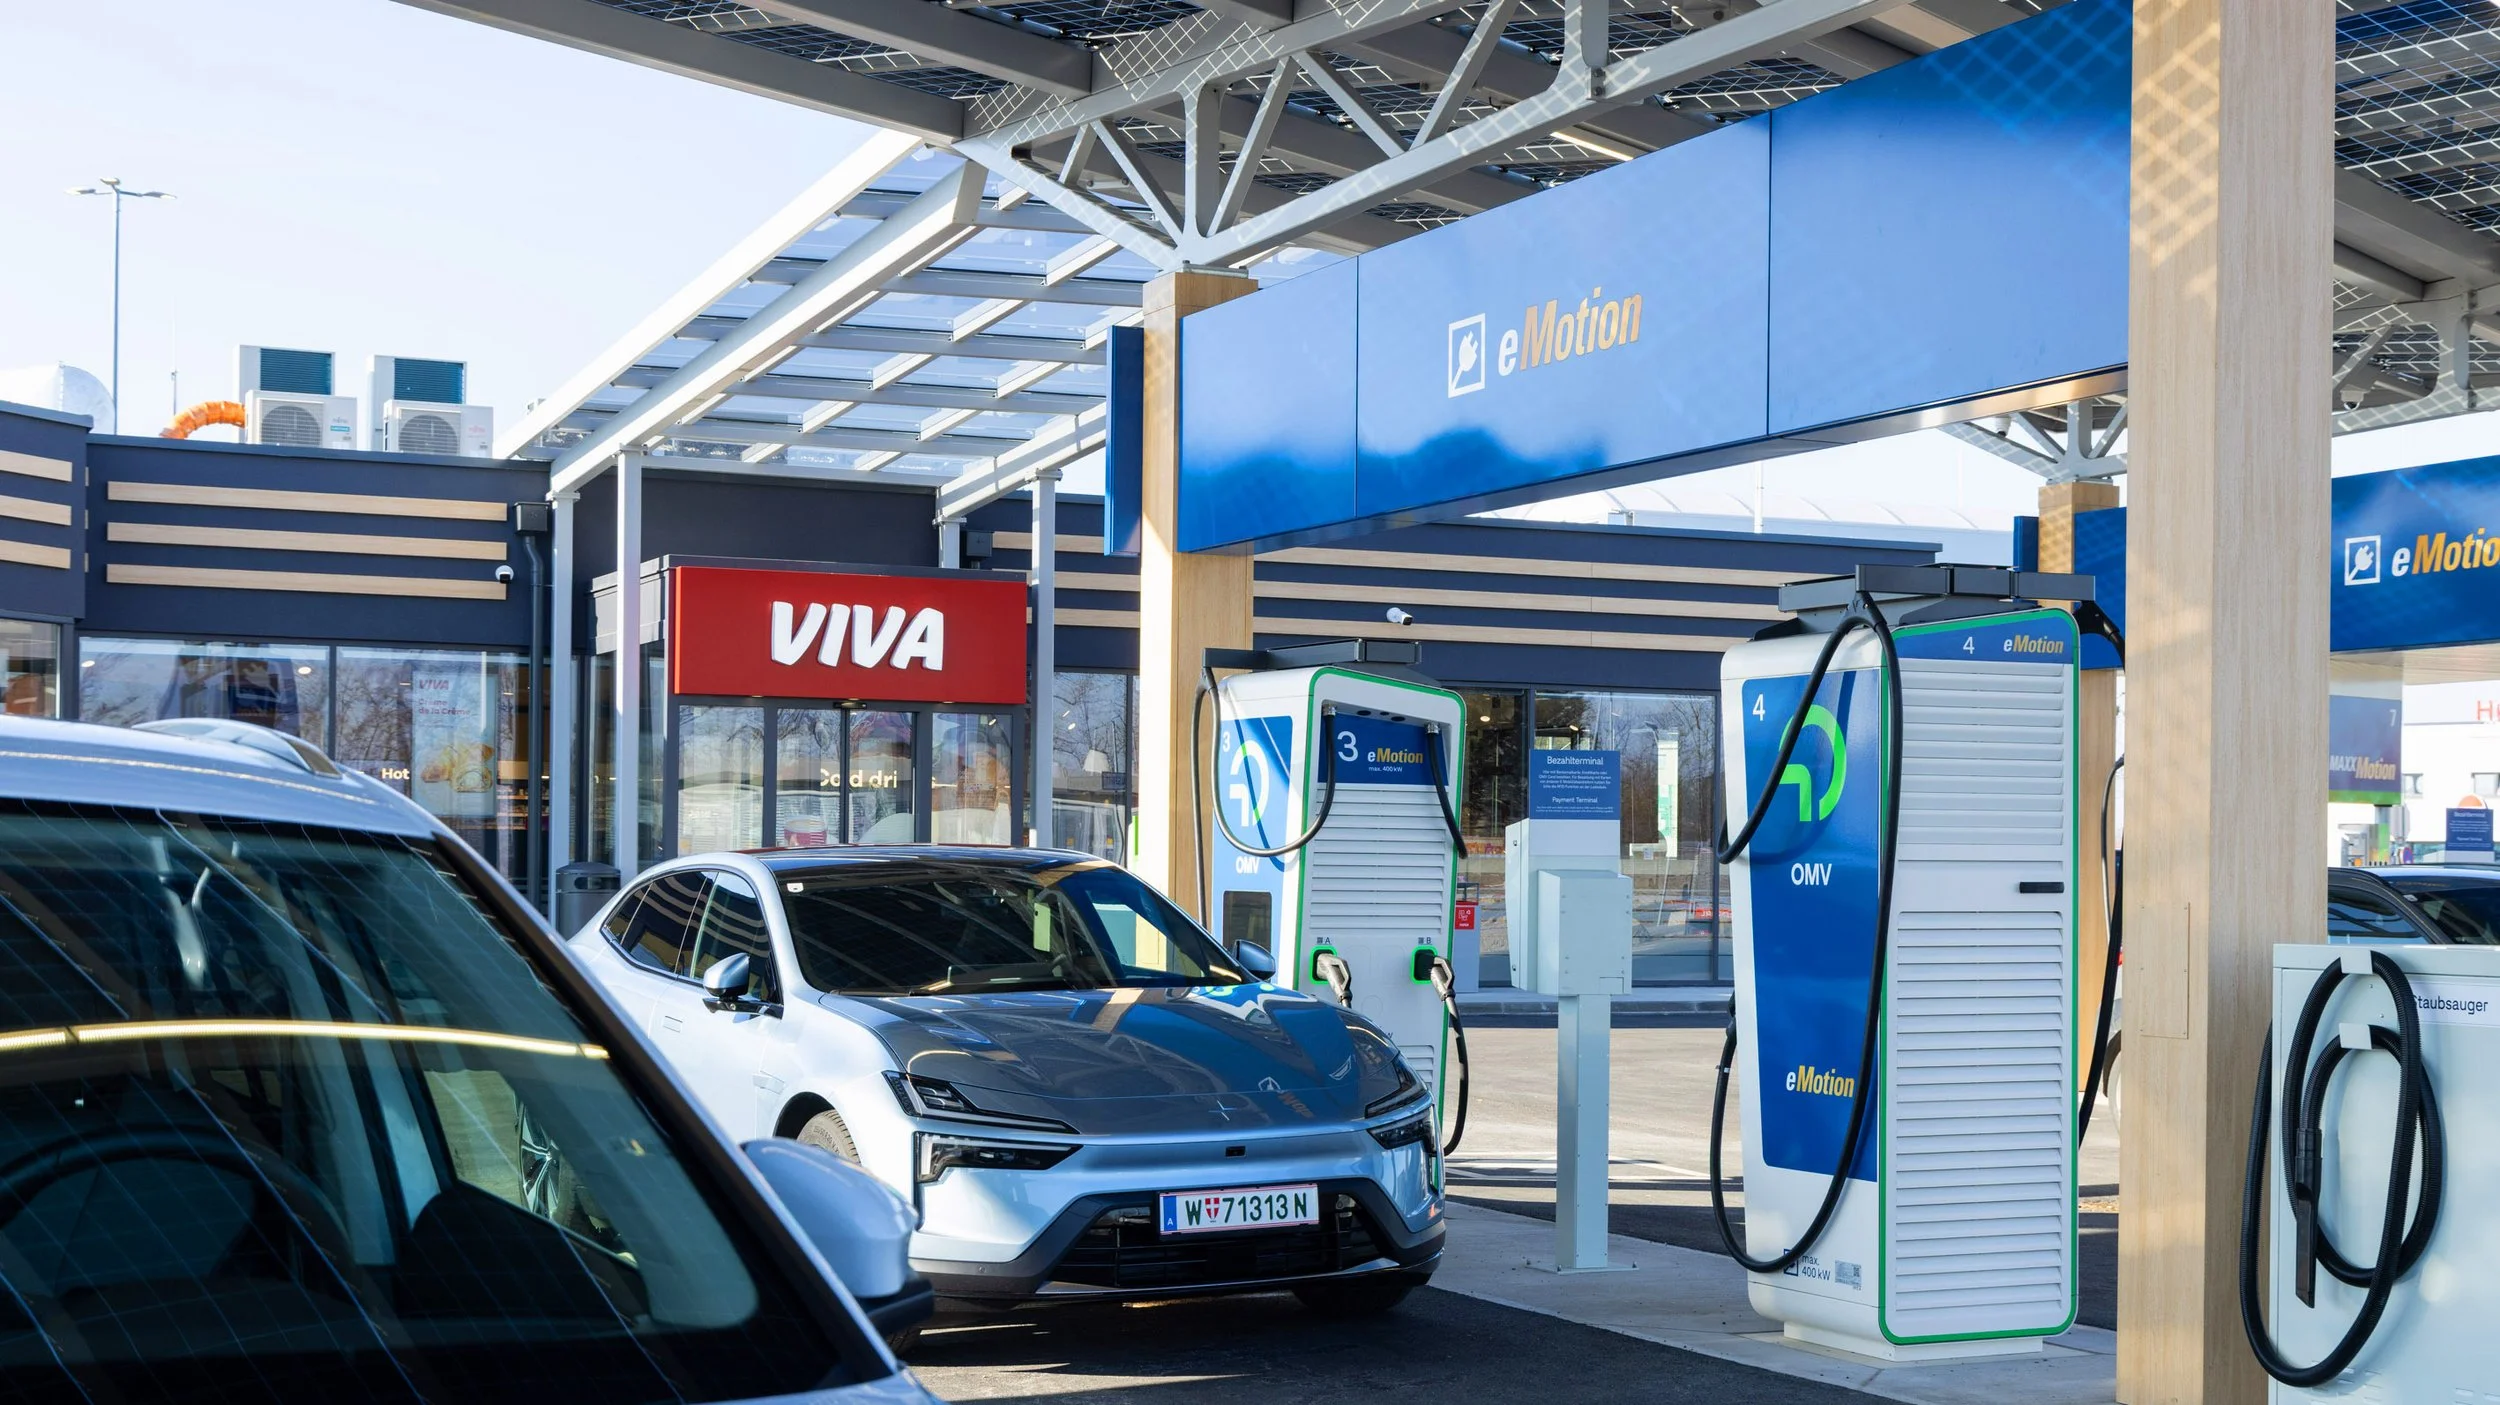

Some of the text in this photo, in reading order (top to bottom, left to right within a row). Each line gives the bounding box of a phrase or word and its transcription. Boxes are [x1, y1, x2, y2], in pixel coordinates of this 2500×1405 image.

[771, 600, 944, 671] VIVA
[1962, 634, 2064, 655] 4 eMotion
[419, 679, 449, 691] VIVA
[1752, 693, 1766, 722] 4
[2389, 708, 2397, 727] 7
[1222, 731, 1231, 753] 3
[1337, 730, 1424, 764] 3 eMotion
[1546, 755, 1604, 766] Bezahlterminal
[381, 767, 410, 780] Hot
[820, 768, 863, 788] Cod
[1551, 796, 1598, 804] Payment Terminal
[1235, 856, 1260, 875] OMV
[1791, 862, 1833, 886] OMV
[1786, 1064, 1855, 1098] eMotion
[1167, 1217, 1174, 1226] A
[1185, 1199, 1202, 1226] W
[1801, 1266, 1816, 1279] 400
[1817, 1268, 1831, 1281] kW
